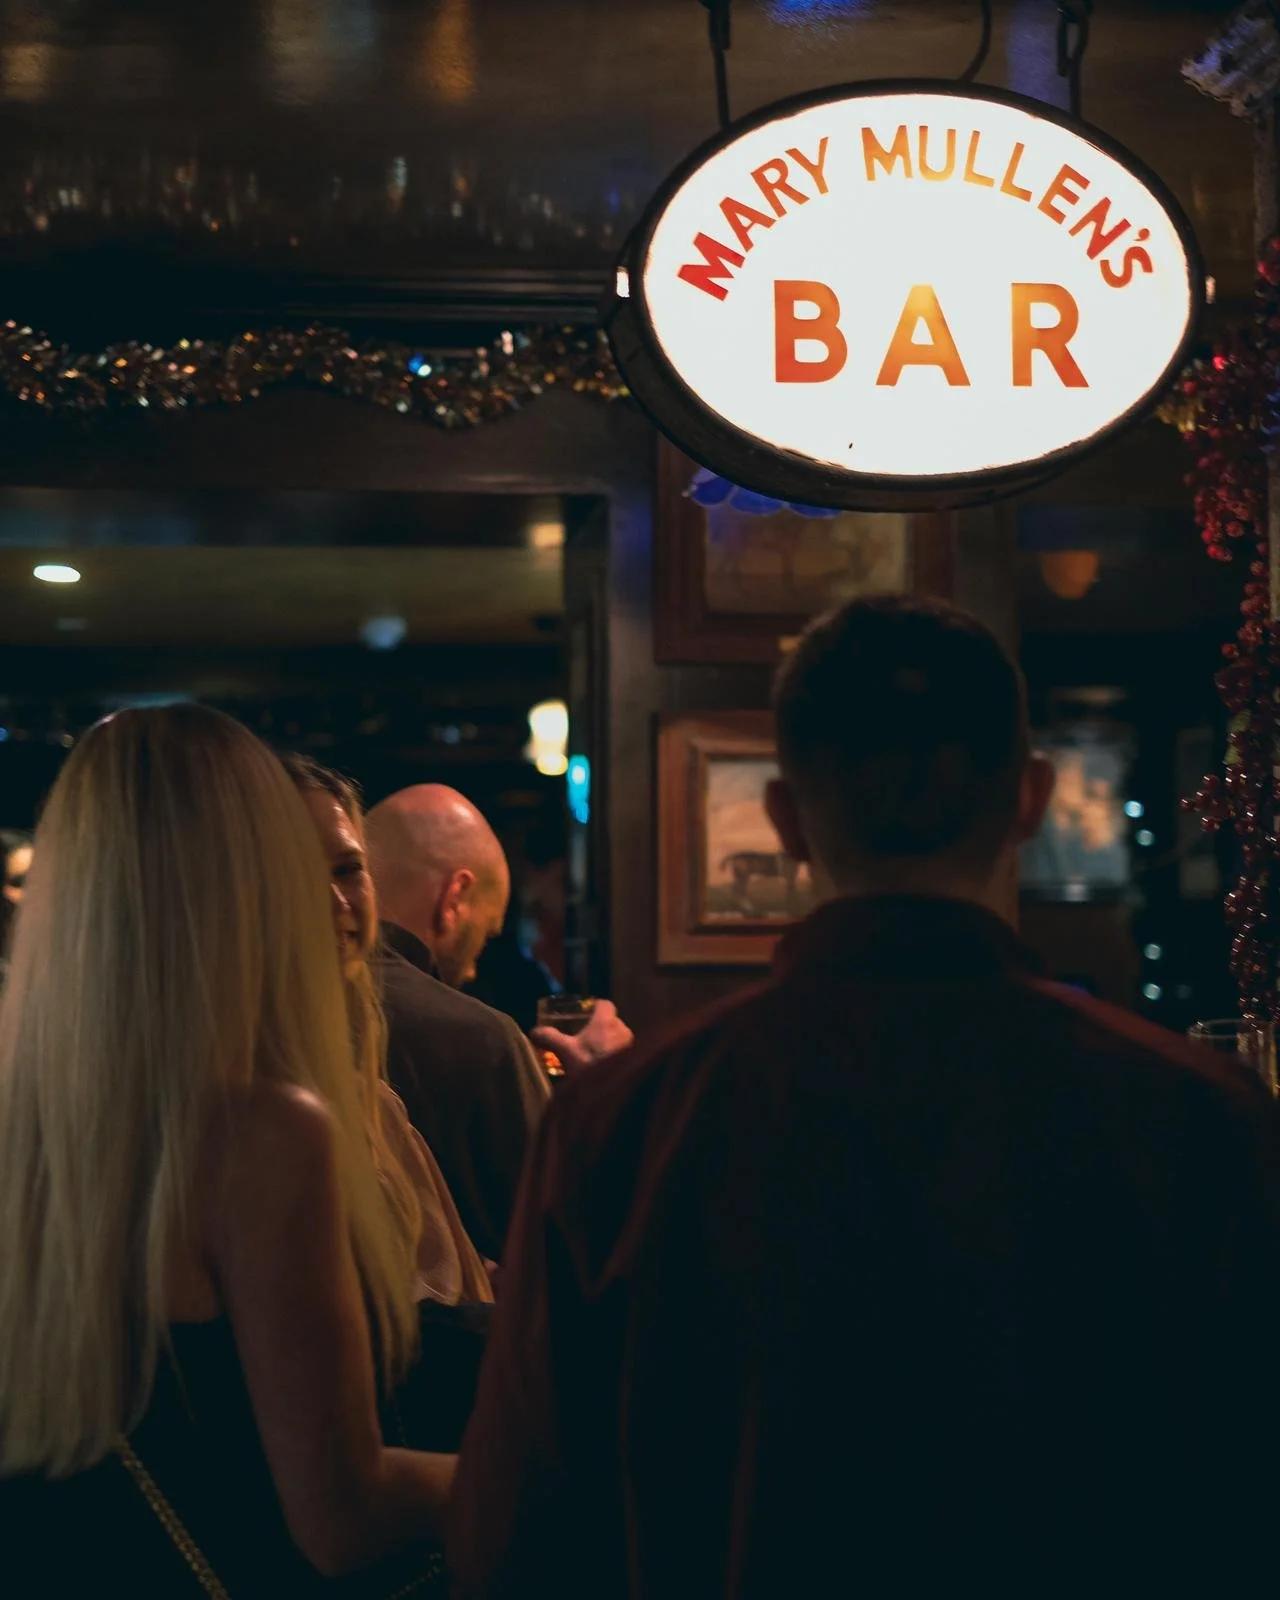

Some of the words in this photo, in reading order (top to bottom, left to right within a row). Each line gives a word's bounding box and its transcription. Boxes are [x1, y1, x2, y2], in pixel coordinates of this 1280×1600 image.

[677, 137, 829, 301] MARY
[861, 125, 1153, 288] MULLEN'S
[774, 280, 1089, 388] BAR
